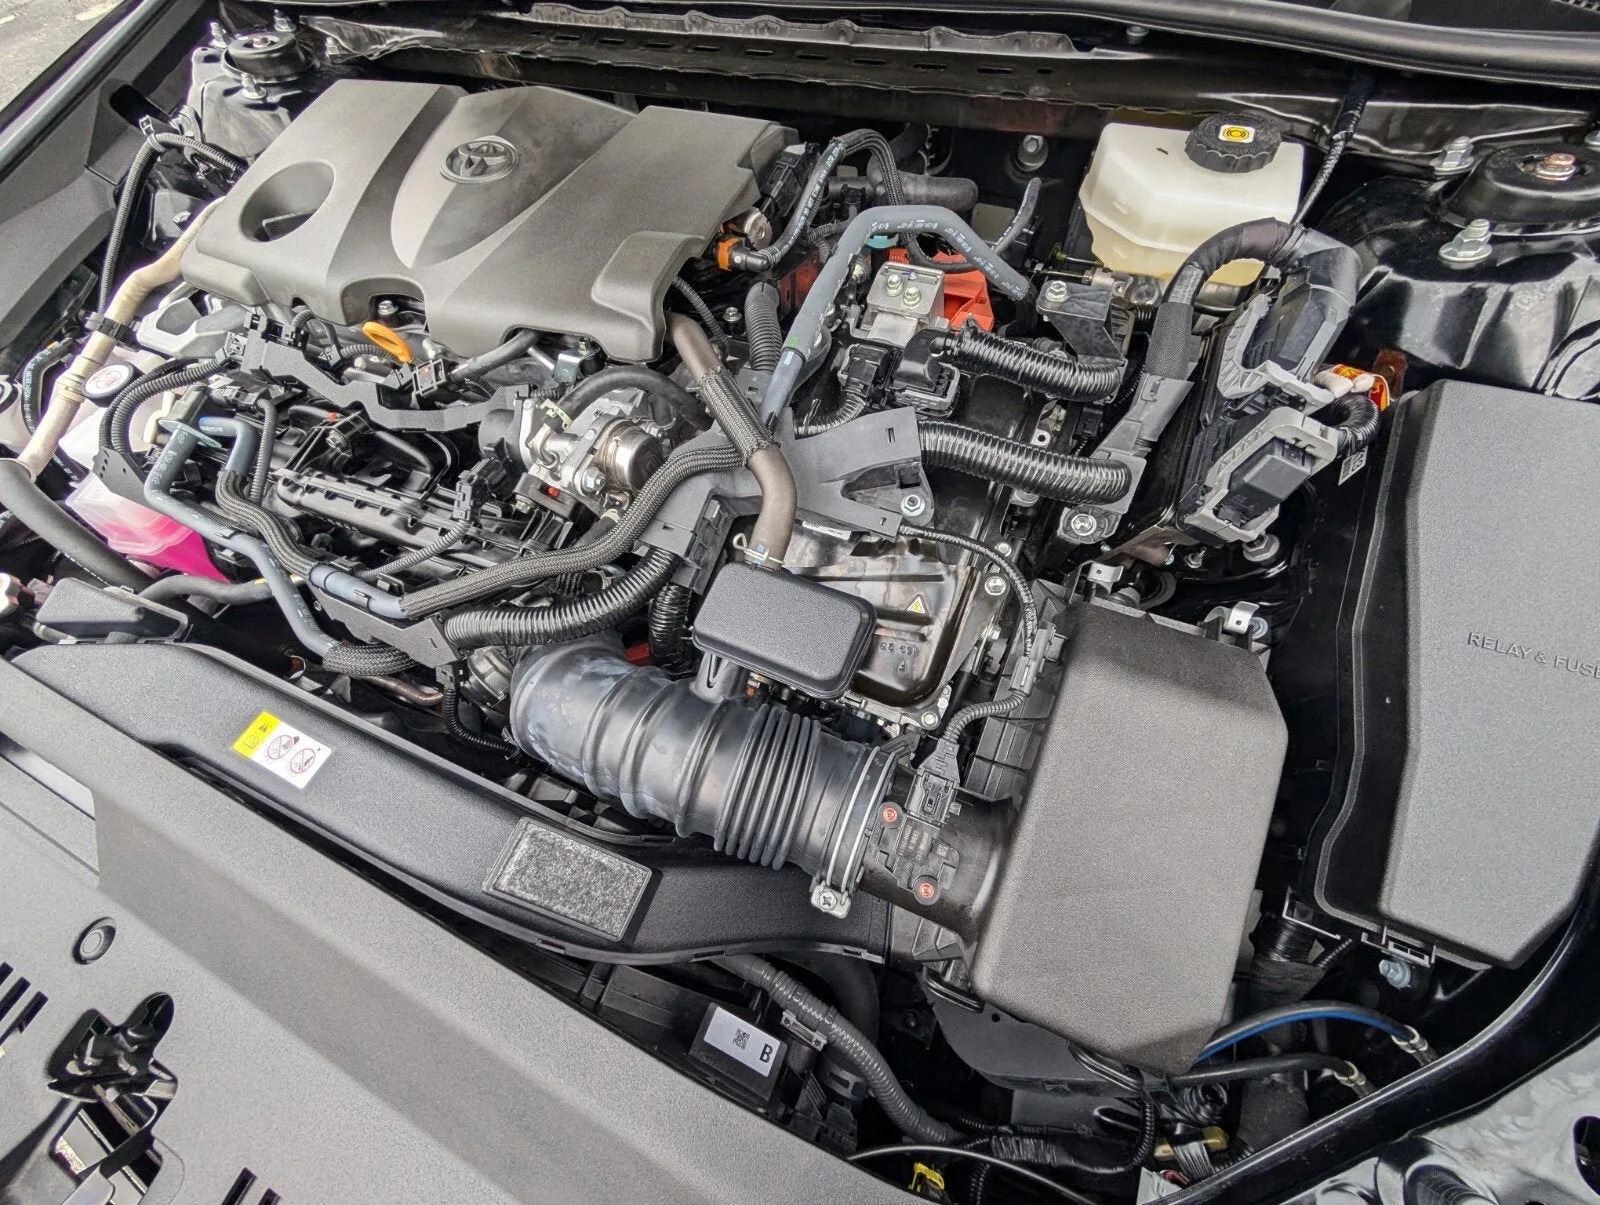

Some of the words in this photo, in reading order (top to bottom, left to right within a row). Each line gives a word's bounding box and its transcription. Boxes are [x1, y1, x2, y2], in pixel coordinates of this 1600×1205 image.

[1467, 631, 1532, 660] RELAY
[1534, 650, 1547, 664] &
[759, 1042, 774, 1064] B
